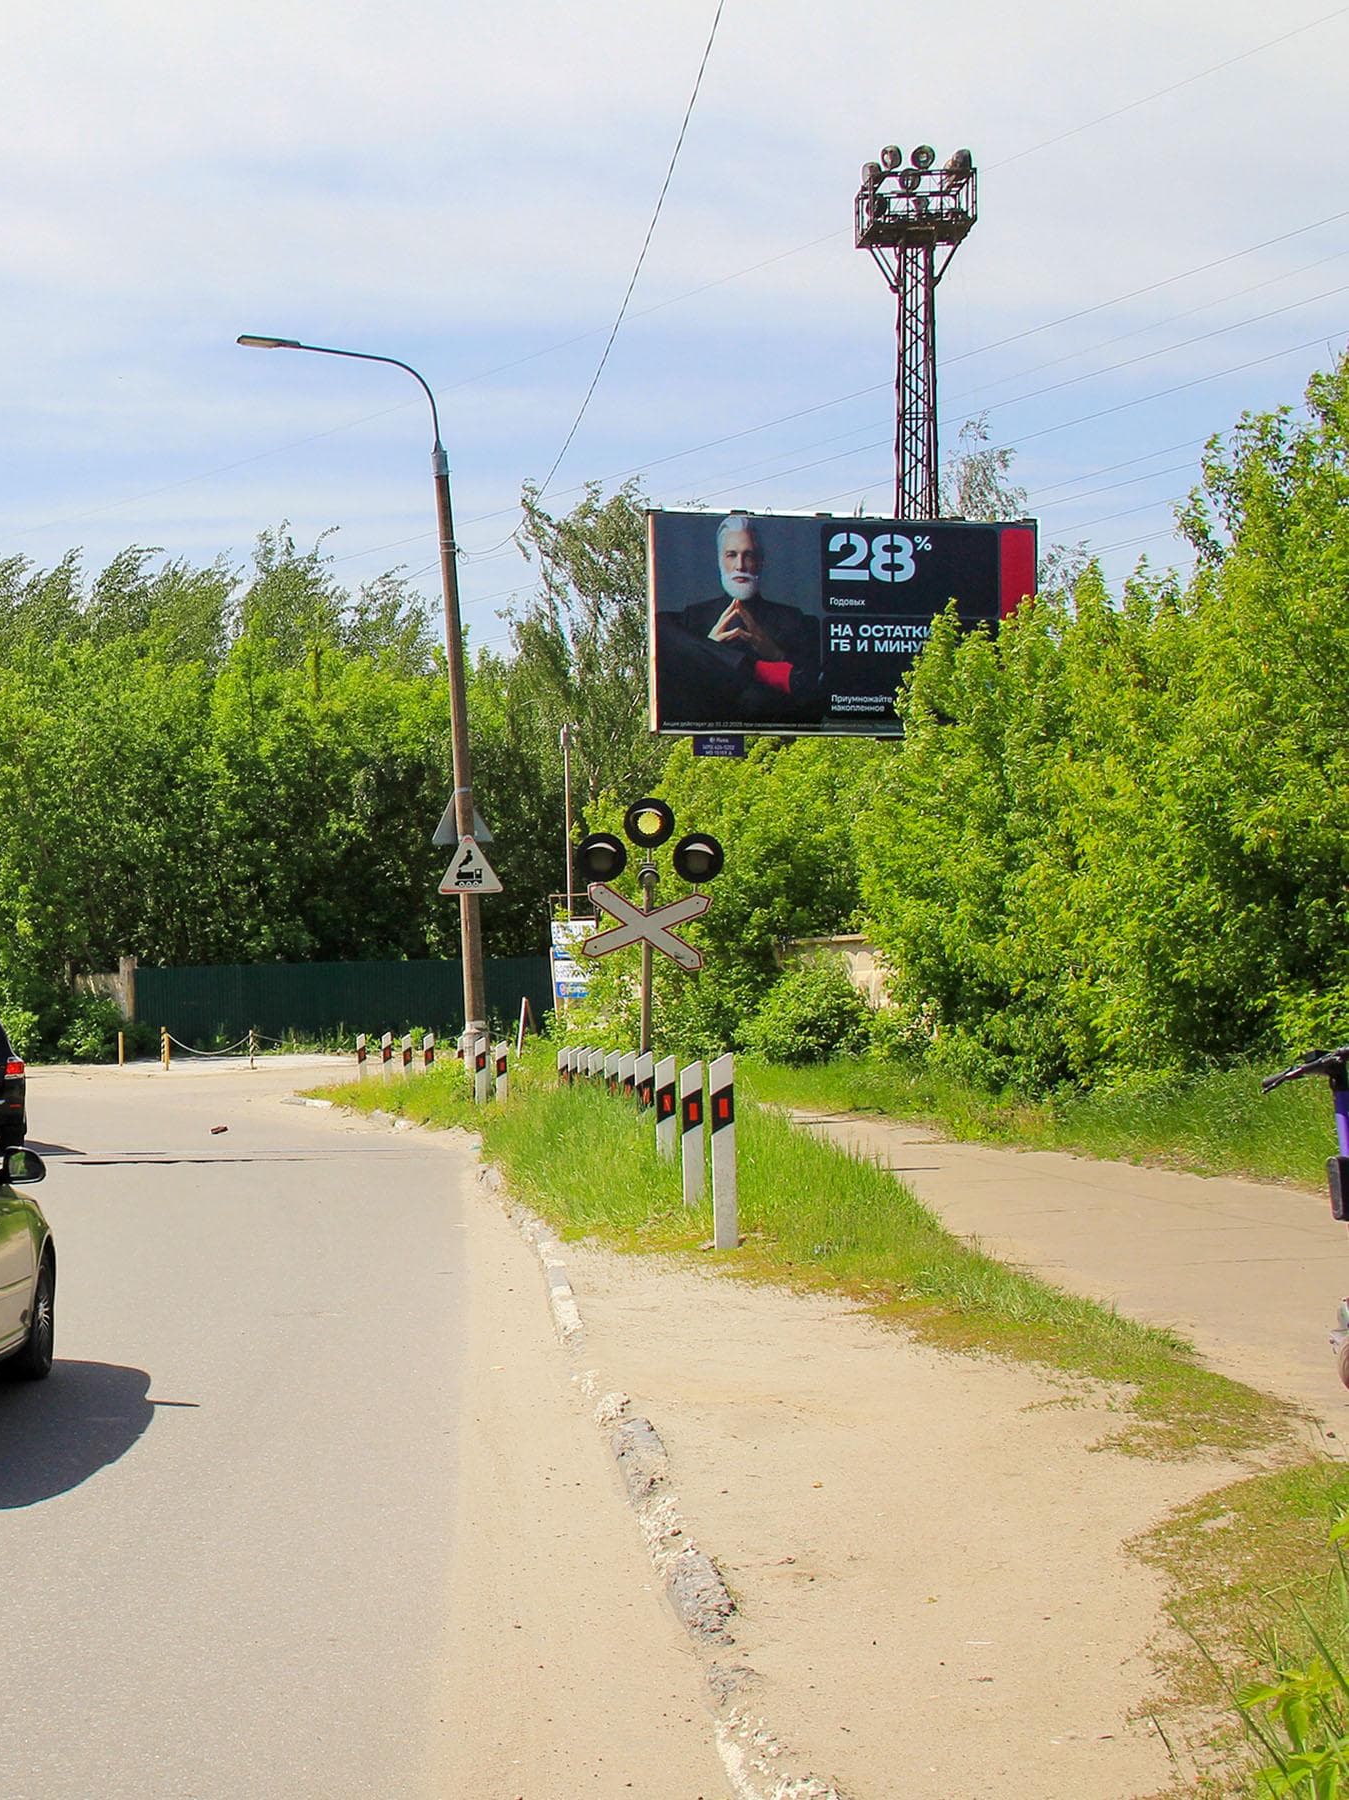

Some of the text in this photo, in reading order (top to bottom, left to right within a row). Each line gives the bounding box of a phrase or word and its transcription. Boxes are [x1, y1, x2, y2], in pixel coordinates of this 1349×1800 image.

[829, 597, 866, 606] Годовых
[830, 624, 854, 636] НА
[830, 639, 925, 653] ГБ И МИНУ
[831, 694, 893, 704] Приумножайте
[831, 704, 885, 712] накопленное
